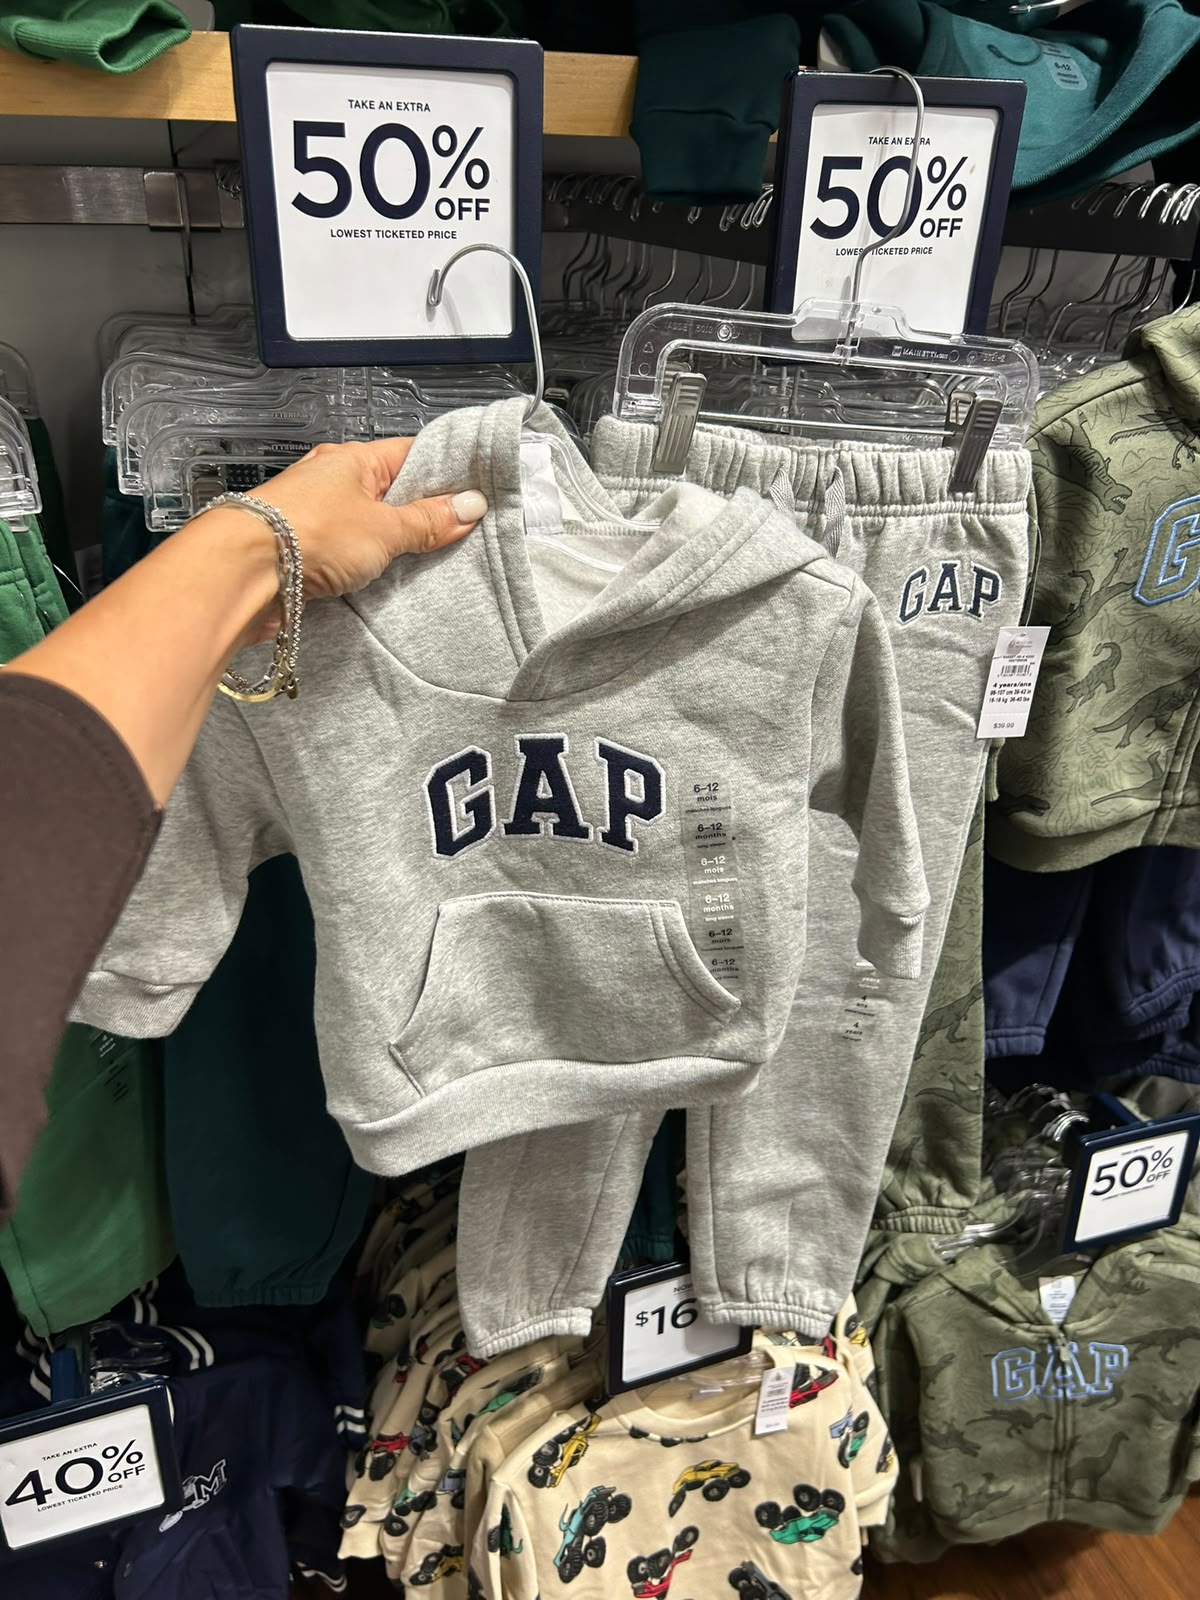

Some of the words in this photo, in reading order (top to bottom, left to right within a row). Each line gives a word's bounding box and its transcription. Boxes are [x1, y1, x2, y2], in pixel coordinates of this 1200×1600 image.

[348, 99, 375, 110] TAKE
[379, 101, 393, 110] AN
[396, 102, 431, 112] EXTRA
[868, 136, 890, 145] TAKE
[891, 136, 903, 145] AN
[905, 137, 931, 145] EXRA
[291, 120, 490, 220] 50%
[809, 155, 969, 240] 50%
[434, 197, 491, 221] OFF
[330, 229, 372, 238] LOWEST
[375, 230, 425, 239] TICKETED
[428, 230, 457, 239] PRICE
[919, 218, 963, 238] OFF
[836, 247, 869, 256] LOWES
[911, 246, 933, 255] PRICE
[897, 560, 1003, 629] GAP
[422, 733, 666, 861] GAP
[695, 832, 727, 840] months
[703, 904, 734, 913] months
[1089, 1146, 1175, 1196] 50%
[1146, 1169, 1172, 1183] OFF
[635, 1298, 698, 1335] $16
[991, 1341, 1130, 1402] GAP
[42, 1452, 60, 1461] TAKE
[74, 1442, 98, 1453] EXTRA
[5, 1438, 144, 1507] 40%
[107, 1464, 146, 1483] OFF
[37, 1500, 65, 1512] LOWEST
[67, 1490, 101, 1504] TICKETED
[103, 1484, 123, 1493] PRICE
